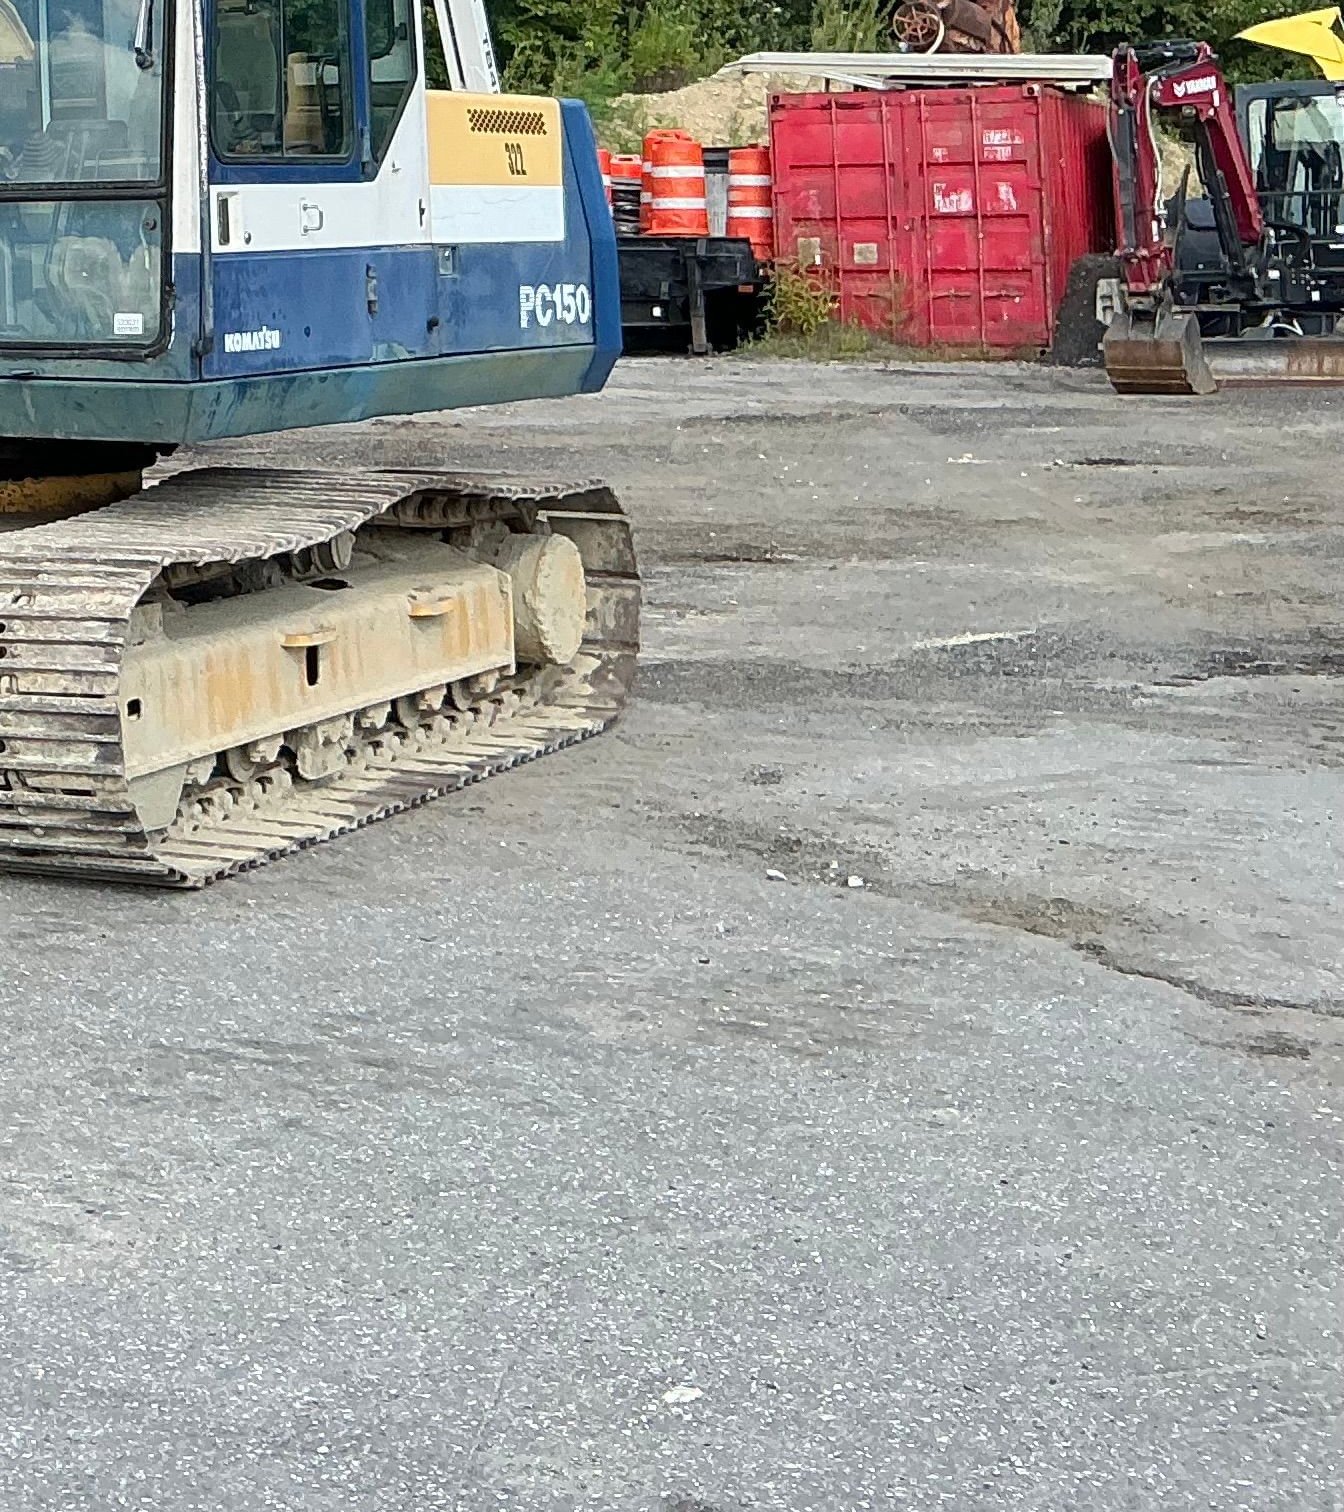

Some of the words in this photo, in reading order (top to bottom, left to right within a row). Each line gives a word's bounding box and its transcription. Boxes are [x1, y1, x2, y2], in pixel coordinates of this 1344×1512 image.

[504, 142, 528, 176] 322
[519, 283, 592, 329] PC150
[224, 325, 281, 353] KOMATSU
